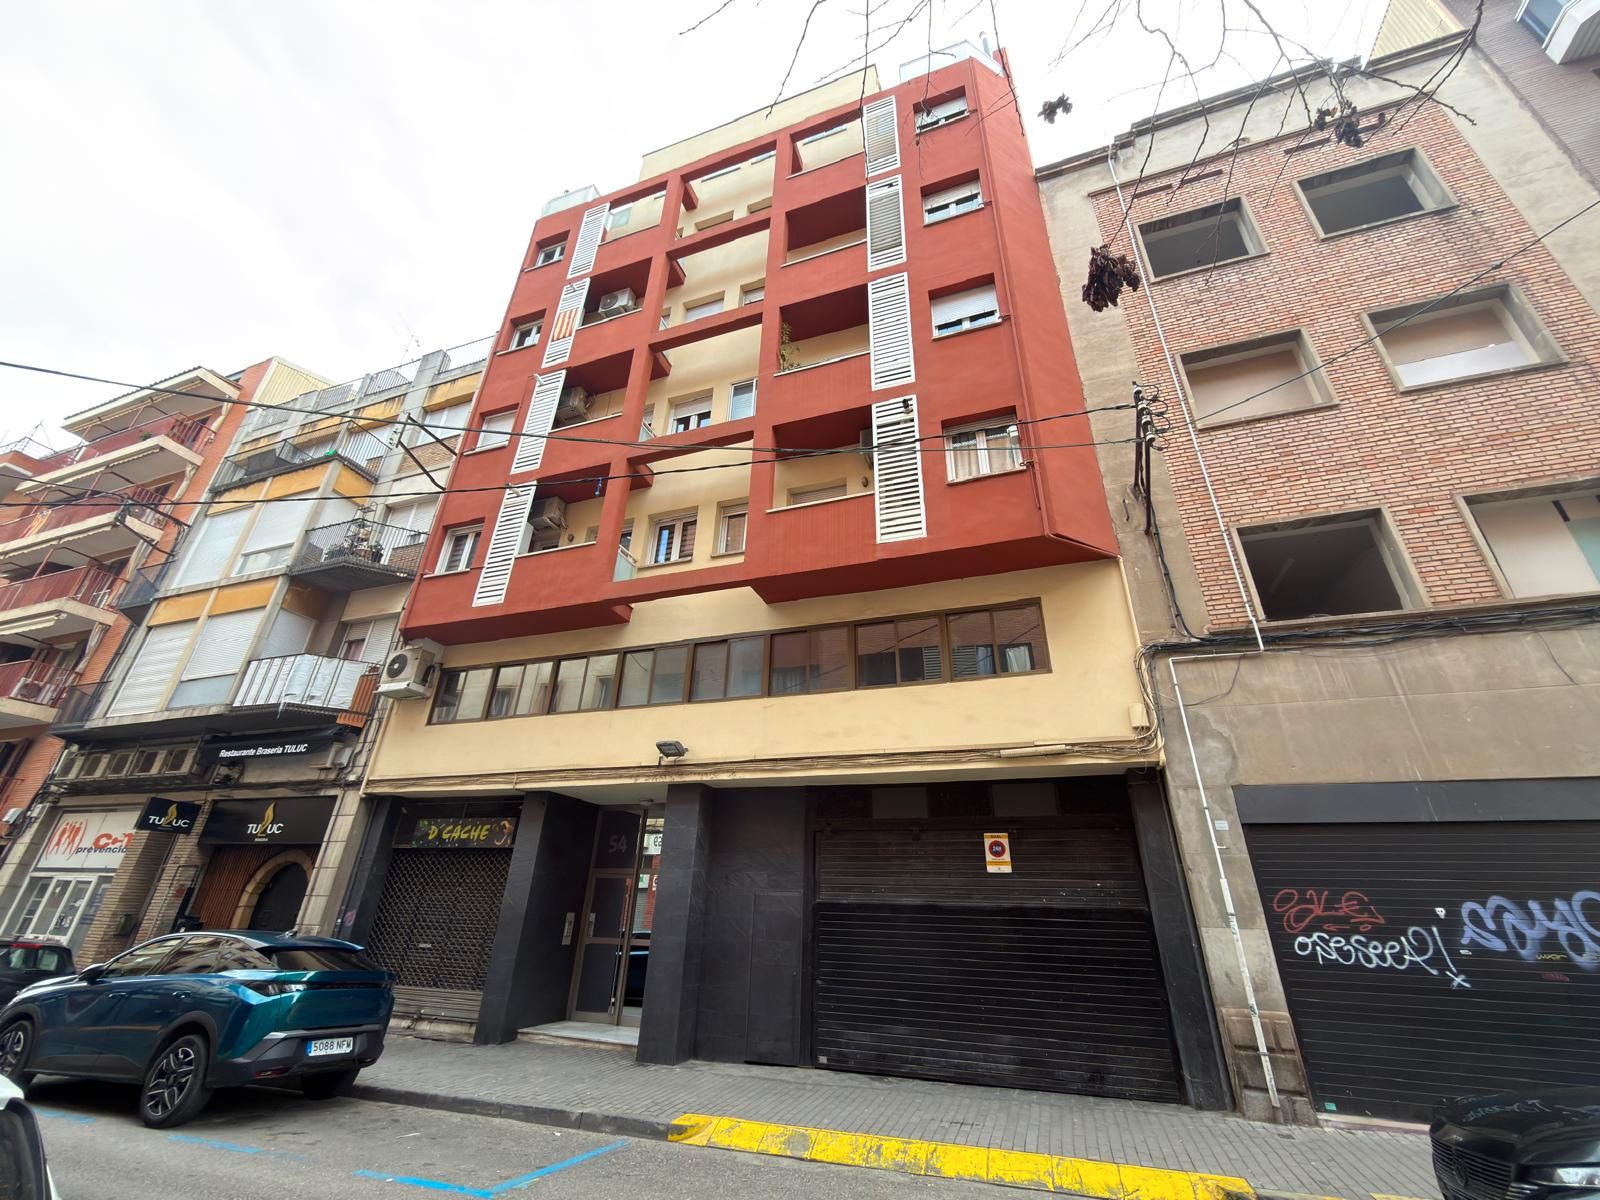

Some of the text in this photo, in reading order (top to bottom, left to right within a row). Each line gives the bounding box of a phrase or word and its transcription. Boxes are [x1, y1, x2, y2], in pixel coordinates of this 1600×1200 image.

[219, 749, 256, 757] Restaurante
[284, 743, 308, 753] TULUC
[608, 834, 628, 853] 54
